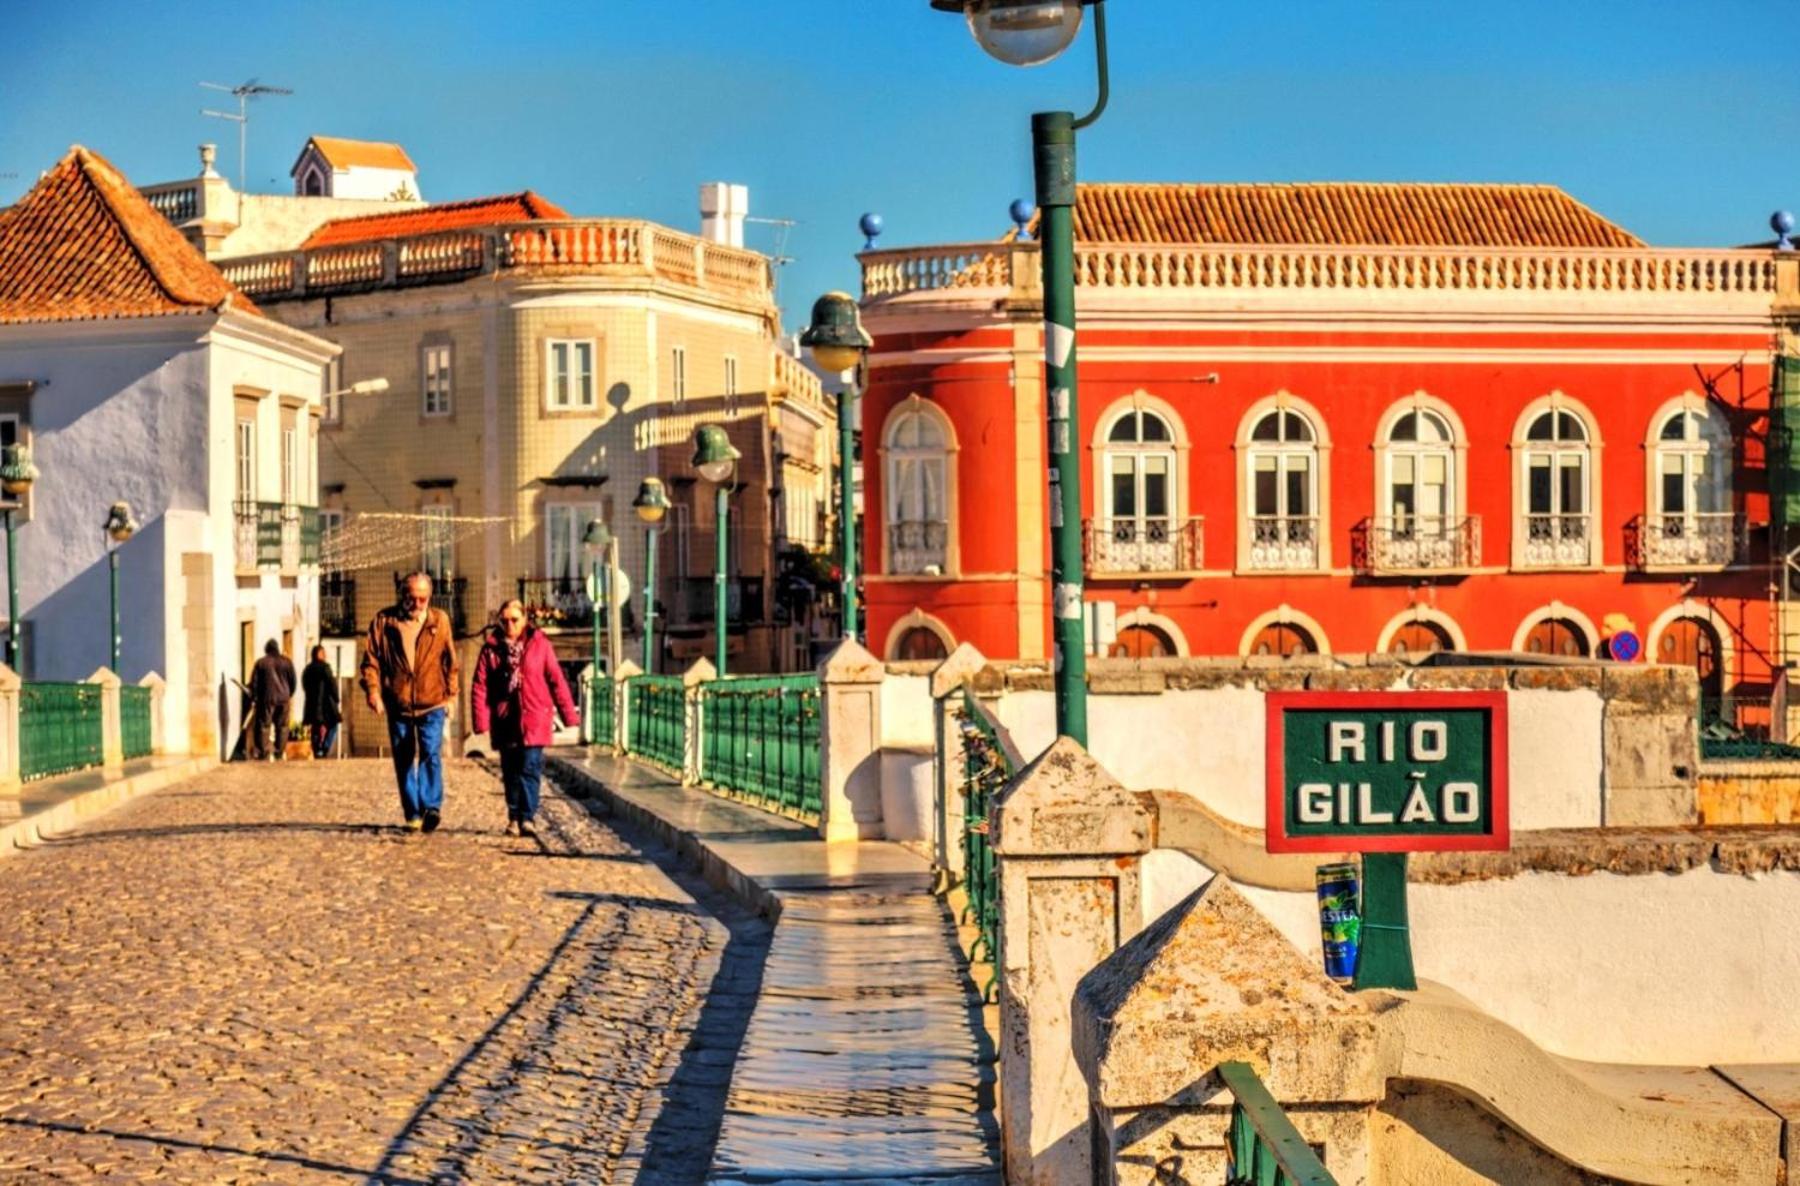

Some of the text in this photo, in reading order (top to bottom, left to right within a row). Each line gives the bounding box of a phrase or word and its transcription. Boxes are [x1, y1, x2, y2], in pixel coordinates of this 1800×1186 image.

[1329, 721, 1447, 761] RIO
[1298, 771, 1479, 823] GILÃO
[1321, 909, 1359, 923] ESTEA
